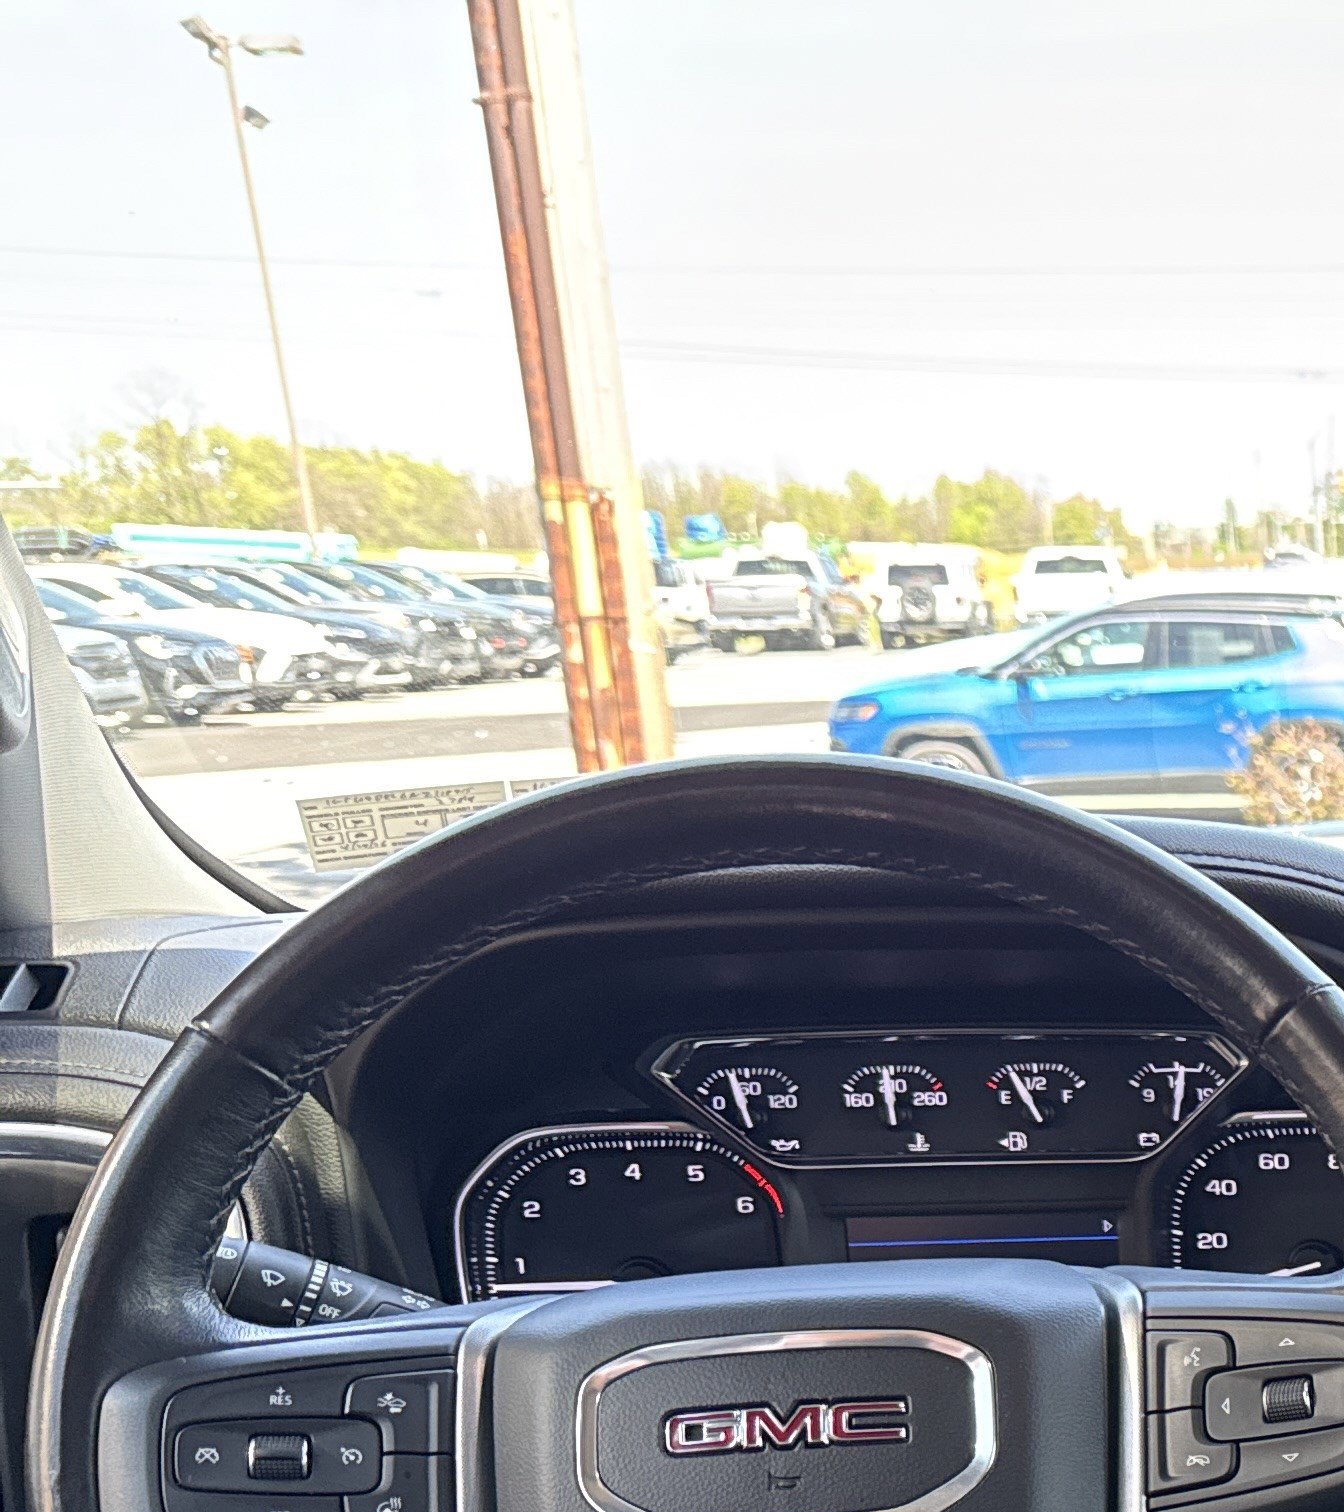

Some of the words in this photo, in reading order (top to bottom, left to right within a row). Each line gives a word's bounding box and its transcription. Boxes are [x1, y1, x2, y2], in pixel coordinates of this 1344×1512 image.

[712, 1096, 726, 1110] 0
[768, 1095, 797, 1108] 120
[845, 1093, 874, 1107] 160
[913, 1092, 947, 1106] 260
[1000, 1090, 1012, 1104] E
[1062, 1090, 1073, 1103] F
[1143, 1089, 1155, 1102] 9
[1258, 1153, 1290, 1170] 60
[568, 1168, 587, 1186] 3
[624, 1163, 642, 1181] 4
[687, 1164, 705, 1182] 5
[1204, 1179, 1238, 1196] 40
[523, 1201, 541, 1218] 2
[736, 1196, 755, 1213] 6
[1196, 1232, 1228, 1249] 20
[514, 1257, 526, 1275] 1
[318, 1304, 341, 1319] OFF
[269, 1394, 292, 1406] RES
[665, 1401, 907, 1453] GMC
